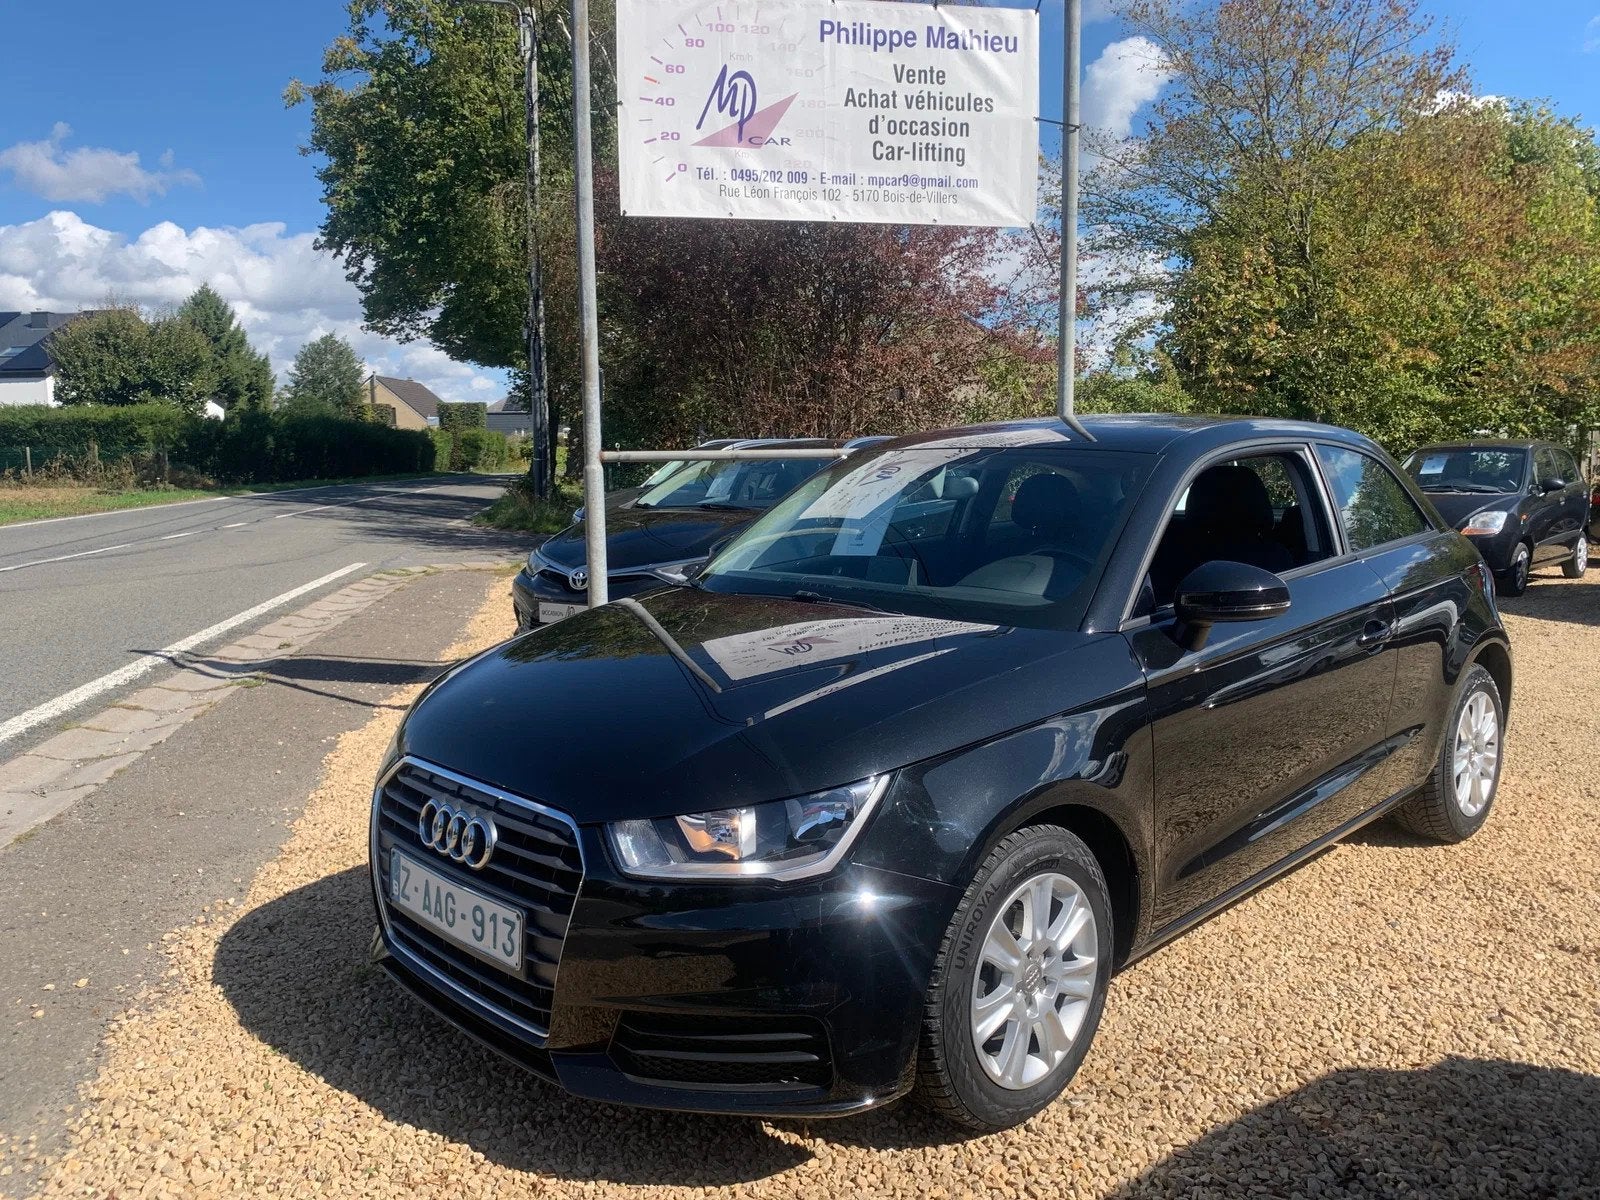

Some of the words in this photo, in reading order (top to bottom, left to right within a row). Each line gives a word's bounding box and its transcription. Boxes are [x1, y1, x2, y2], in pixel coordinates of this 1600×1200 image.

[706, 24, 735, 33] 100
[741, 25, 770, 35] 120
[819, 20, 917, 52] Philippe
[926, 26, 1018, 53] Mathieu
[685, 39, 705, 48] 80
[665, 65, 685, 74] 60
[893, 64, 946, 85] Vente
[655, 97, 675, 106] 40
[844, 87, 897, 110] Achat
[904, 90, 994, 113] véhicules
[660, 132, 681, 141] 20
[868, 115, 970, 137] d’occasion
[748, 137, 792, 146] CAR
[872, 140, 966, 167] Car-lifting
[677, 163, 688, 172] 0
[696, 167, 718, 180] Tél.
[731, 168, 783, 183] 0495/202
[787, 171, 808, 184] 009
[820, 172, 856, 186] E-mail
[868, 174, 979, 190] mpcar9@gmail.com
[720, 184, 740, 198] Rue
[744, 185, 770, 199] Léon
[774, 186, 818, 203] François
[822, 189, 841, 202] 102
[853, 189, 879, 203] 5170
[883, 190, 958, 205] Bois-de-Villers
[400, 865, 517, 958] Z-AAG-913
[955, 882, 1001, 970] UNIROYAL
